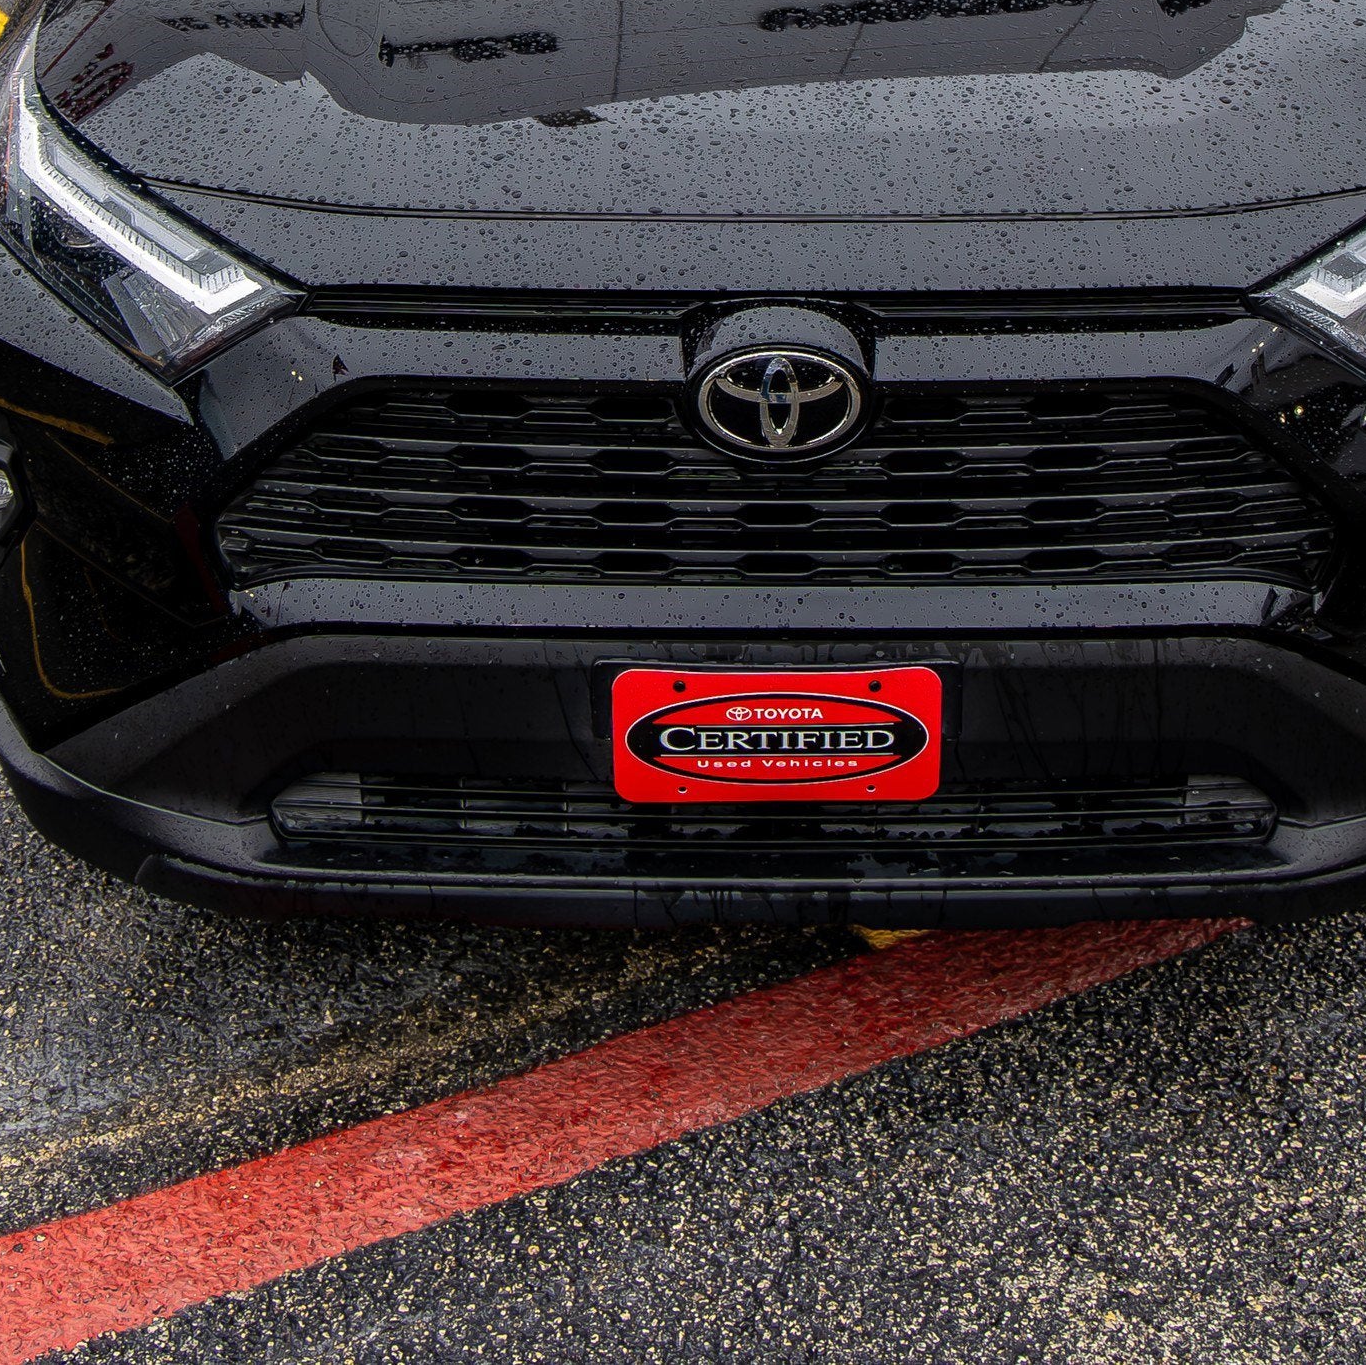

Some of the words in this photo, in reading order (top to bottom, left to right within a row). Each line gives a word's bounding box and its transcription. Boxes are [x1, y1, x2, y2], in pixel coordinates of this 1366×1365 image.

[753, 708, 824, 719] TOYOTA
[696, 759, 752, 768] Used
[761, 758, 858, 768] Vehicles
